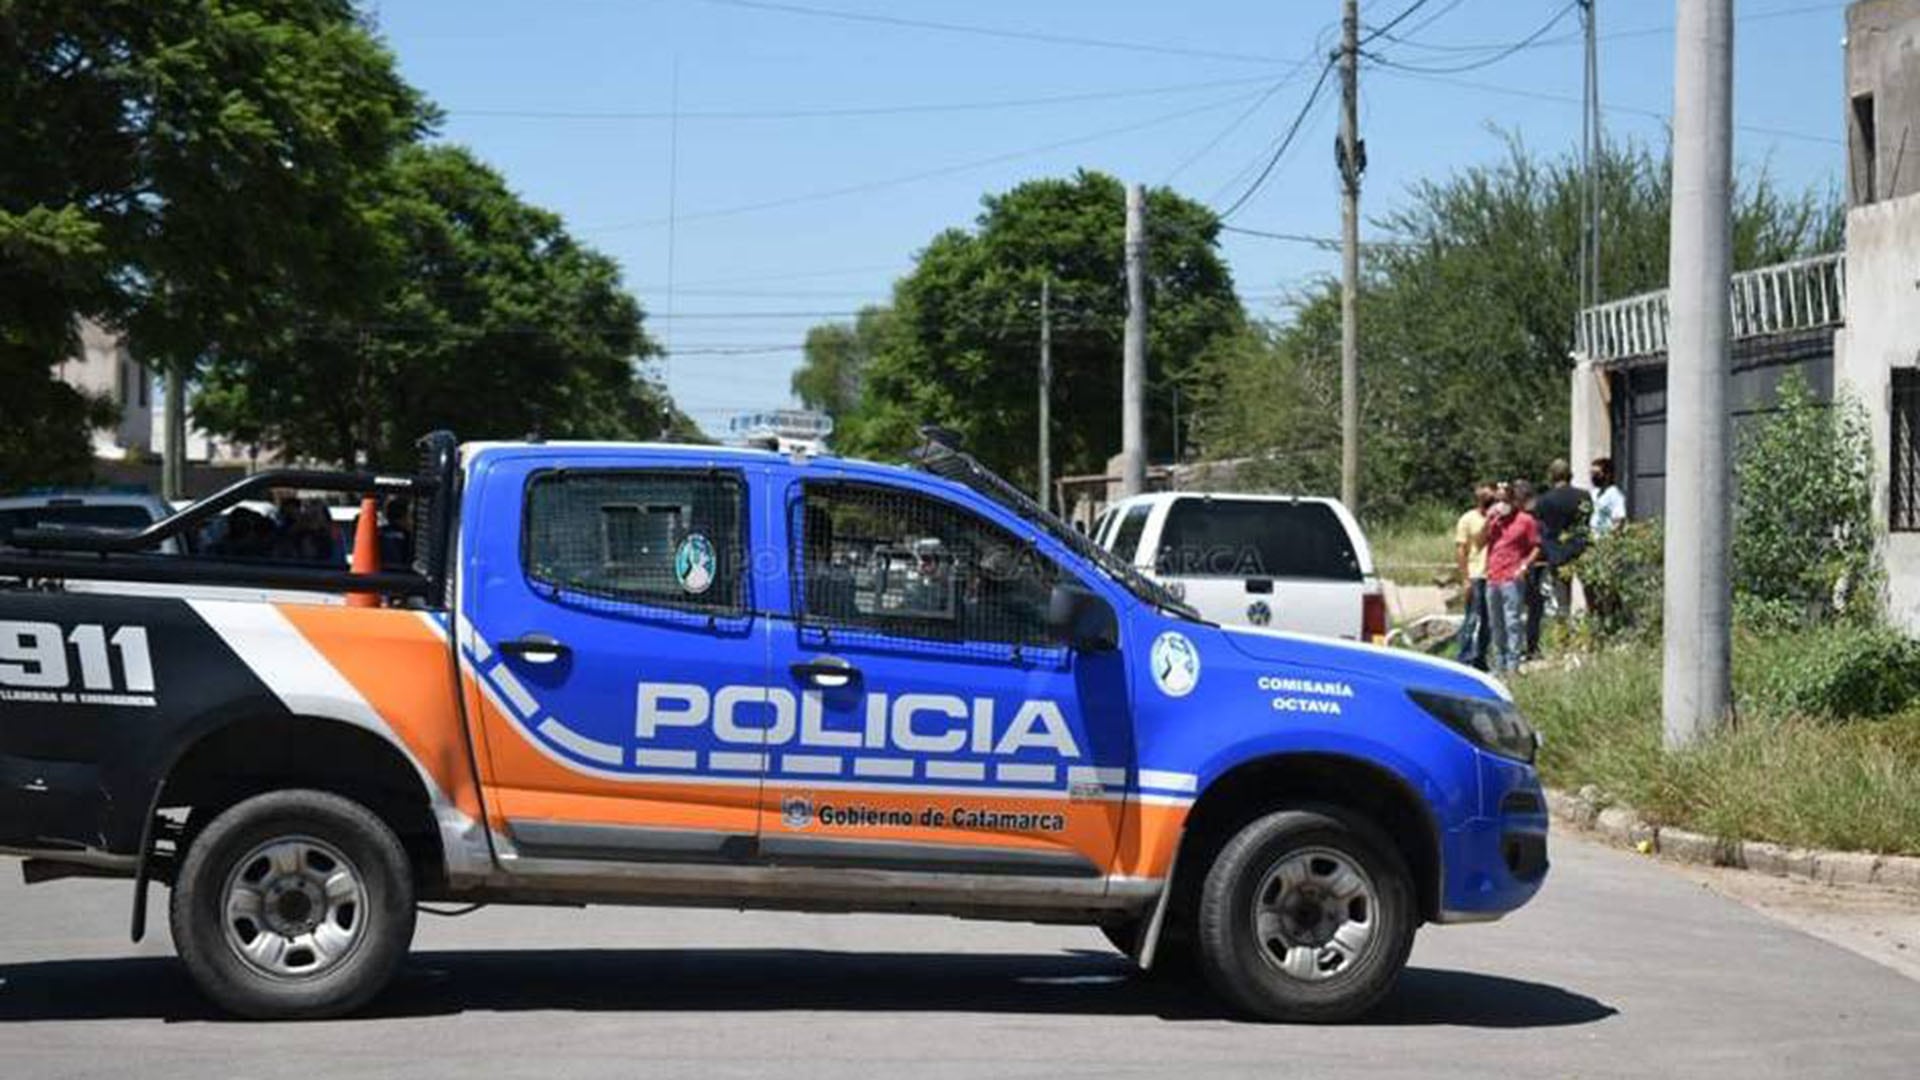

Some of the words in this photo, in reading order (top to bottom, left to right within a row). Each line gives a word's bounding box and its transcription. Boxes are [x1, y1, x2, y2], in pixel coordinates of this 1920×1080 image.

[0, 620, 154, 692] 911
[1258, 677, 1354, 697] COMISARÍA
[634, 682, 1080, 757] POLICIA
[1272, 697, 1341, 715] OCTAVA
[818, 805, 913, 827] Gobierno
[919, 808, 945, 827] de
[952, 807, 1064, 832] Catamarca
